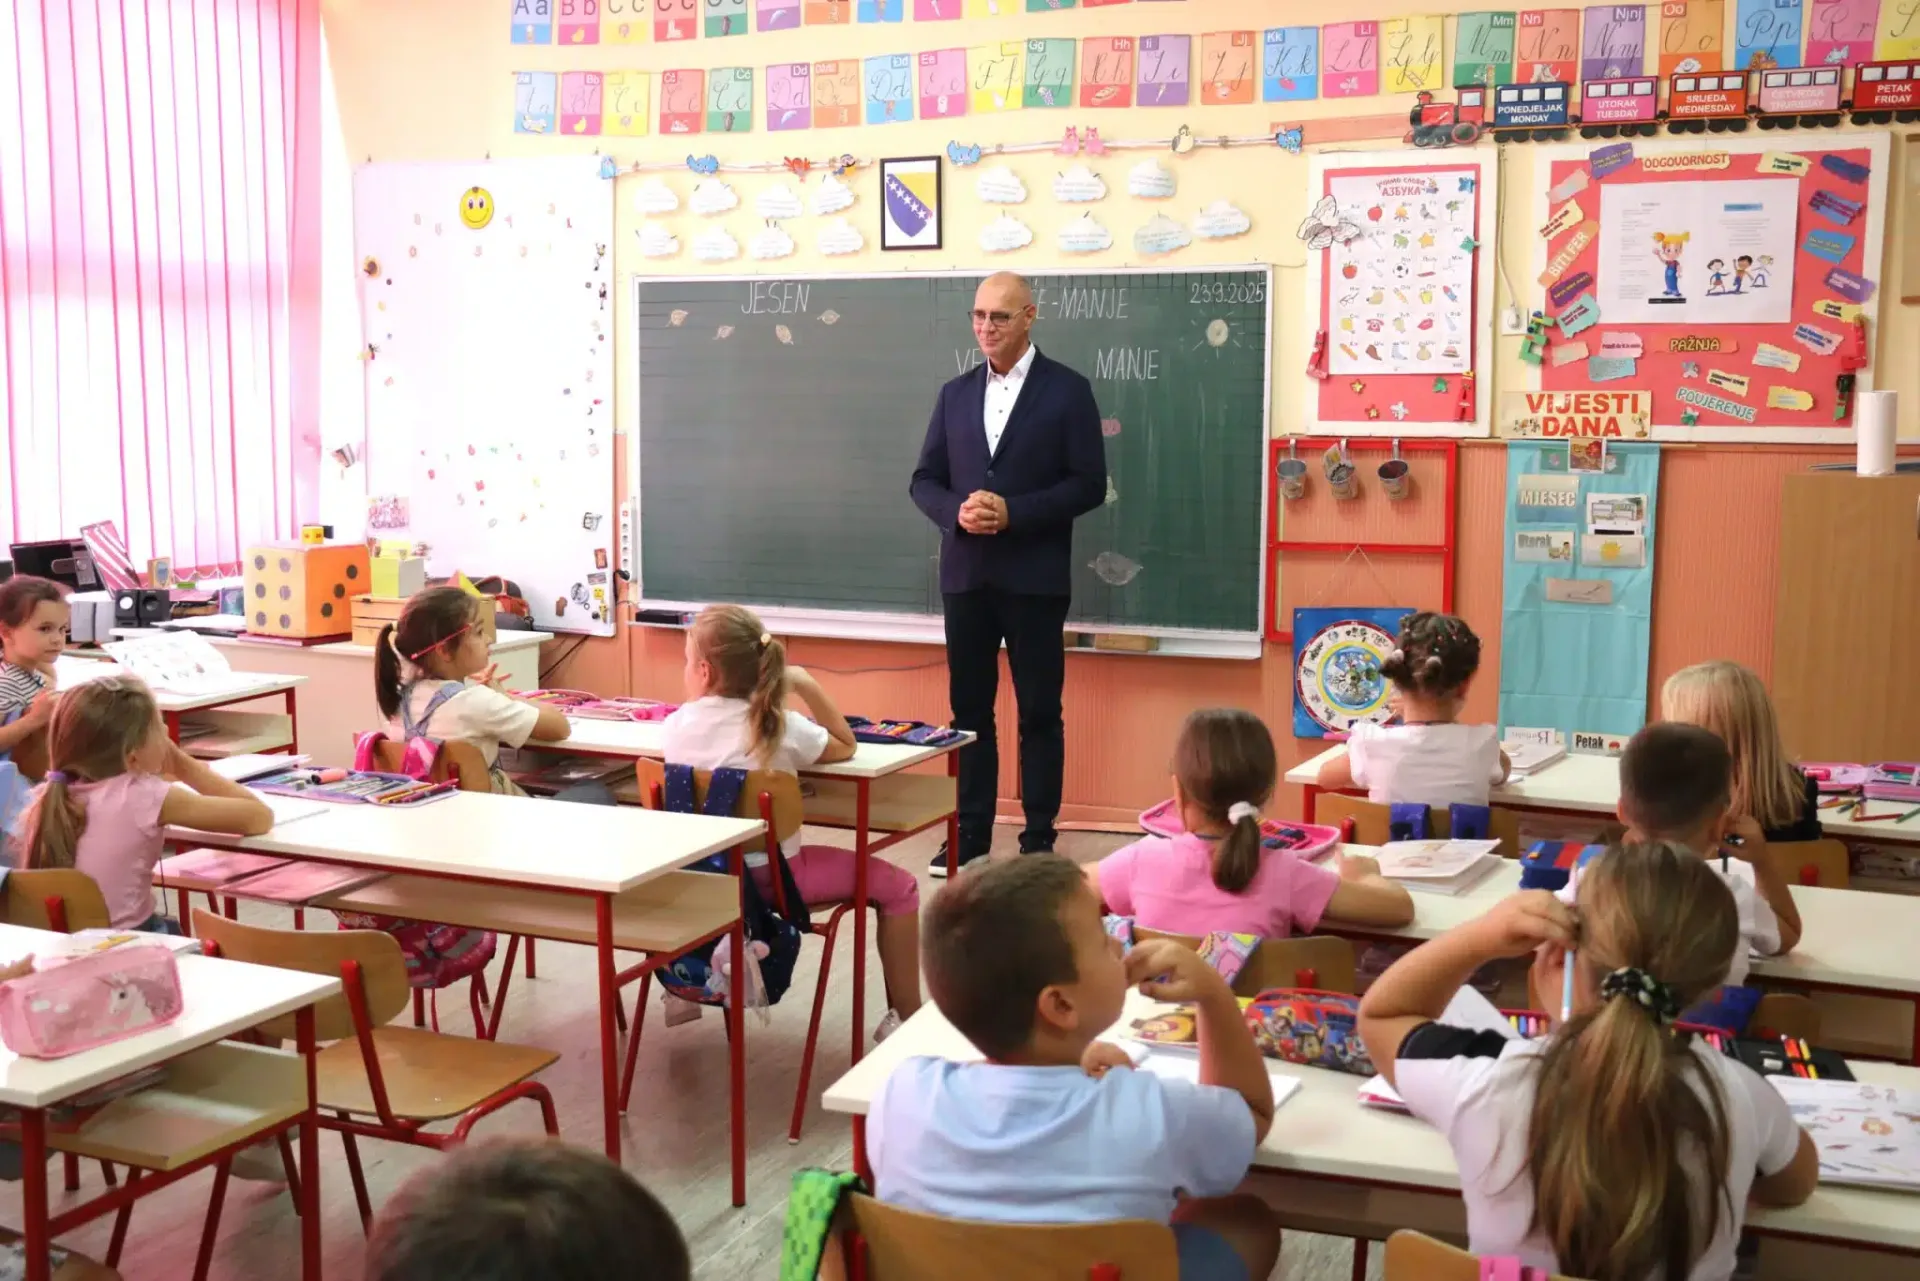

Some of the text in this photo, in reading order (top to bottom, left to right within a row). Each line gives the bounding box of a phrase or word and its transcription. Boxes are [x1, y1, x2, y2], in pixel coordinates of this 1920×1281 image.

[1664, 4, 1684, 15] Oo
[1493, 16, 1513, 25] Mm
[1523, 14, 1541, 25] Nn
[1267, 31, 1282, 43] Kk
[1028, 40, 1044, 52] Gg
[1115, 39, 1131, 49] Hh
[792, 65, 808, 76] Dd
[1877, 84, 1913, 93] PETAK
[1598, 99, 1637, 109] UTORAK
[1686, 93, 1727, 104] SRIJEDA
[1874, 94, 1913, 104] FRIDAY
[1497, 103, 1563, 114] PONEDJELJAK
[1596, 109, 1639, 119] TUESDAY
[1675, 103, 1737, 114] WEDNESDAY
[1510, 114, 1550, 124] MONDAY
[1381, 186, 1421, 196] АЗБУКА
[741, 281, 811, 314] JESEN
[1669, 336, 1720, 352] PAŽNJA
[1096, 346, 1160, 381] MANJE
[1525, 393, 1639, 414] VIJESTI
[1542, 416, 1622, 437] DANA
[1519, 489, 1577, 507] MJESEC
[1576, 734, 1604, 749] Petak
